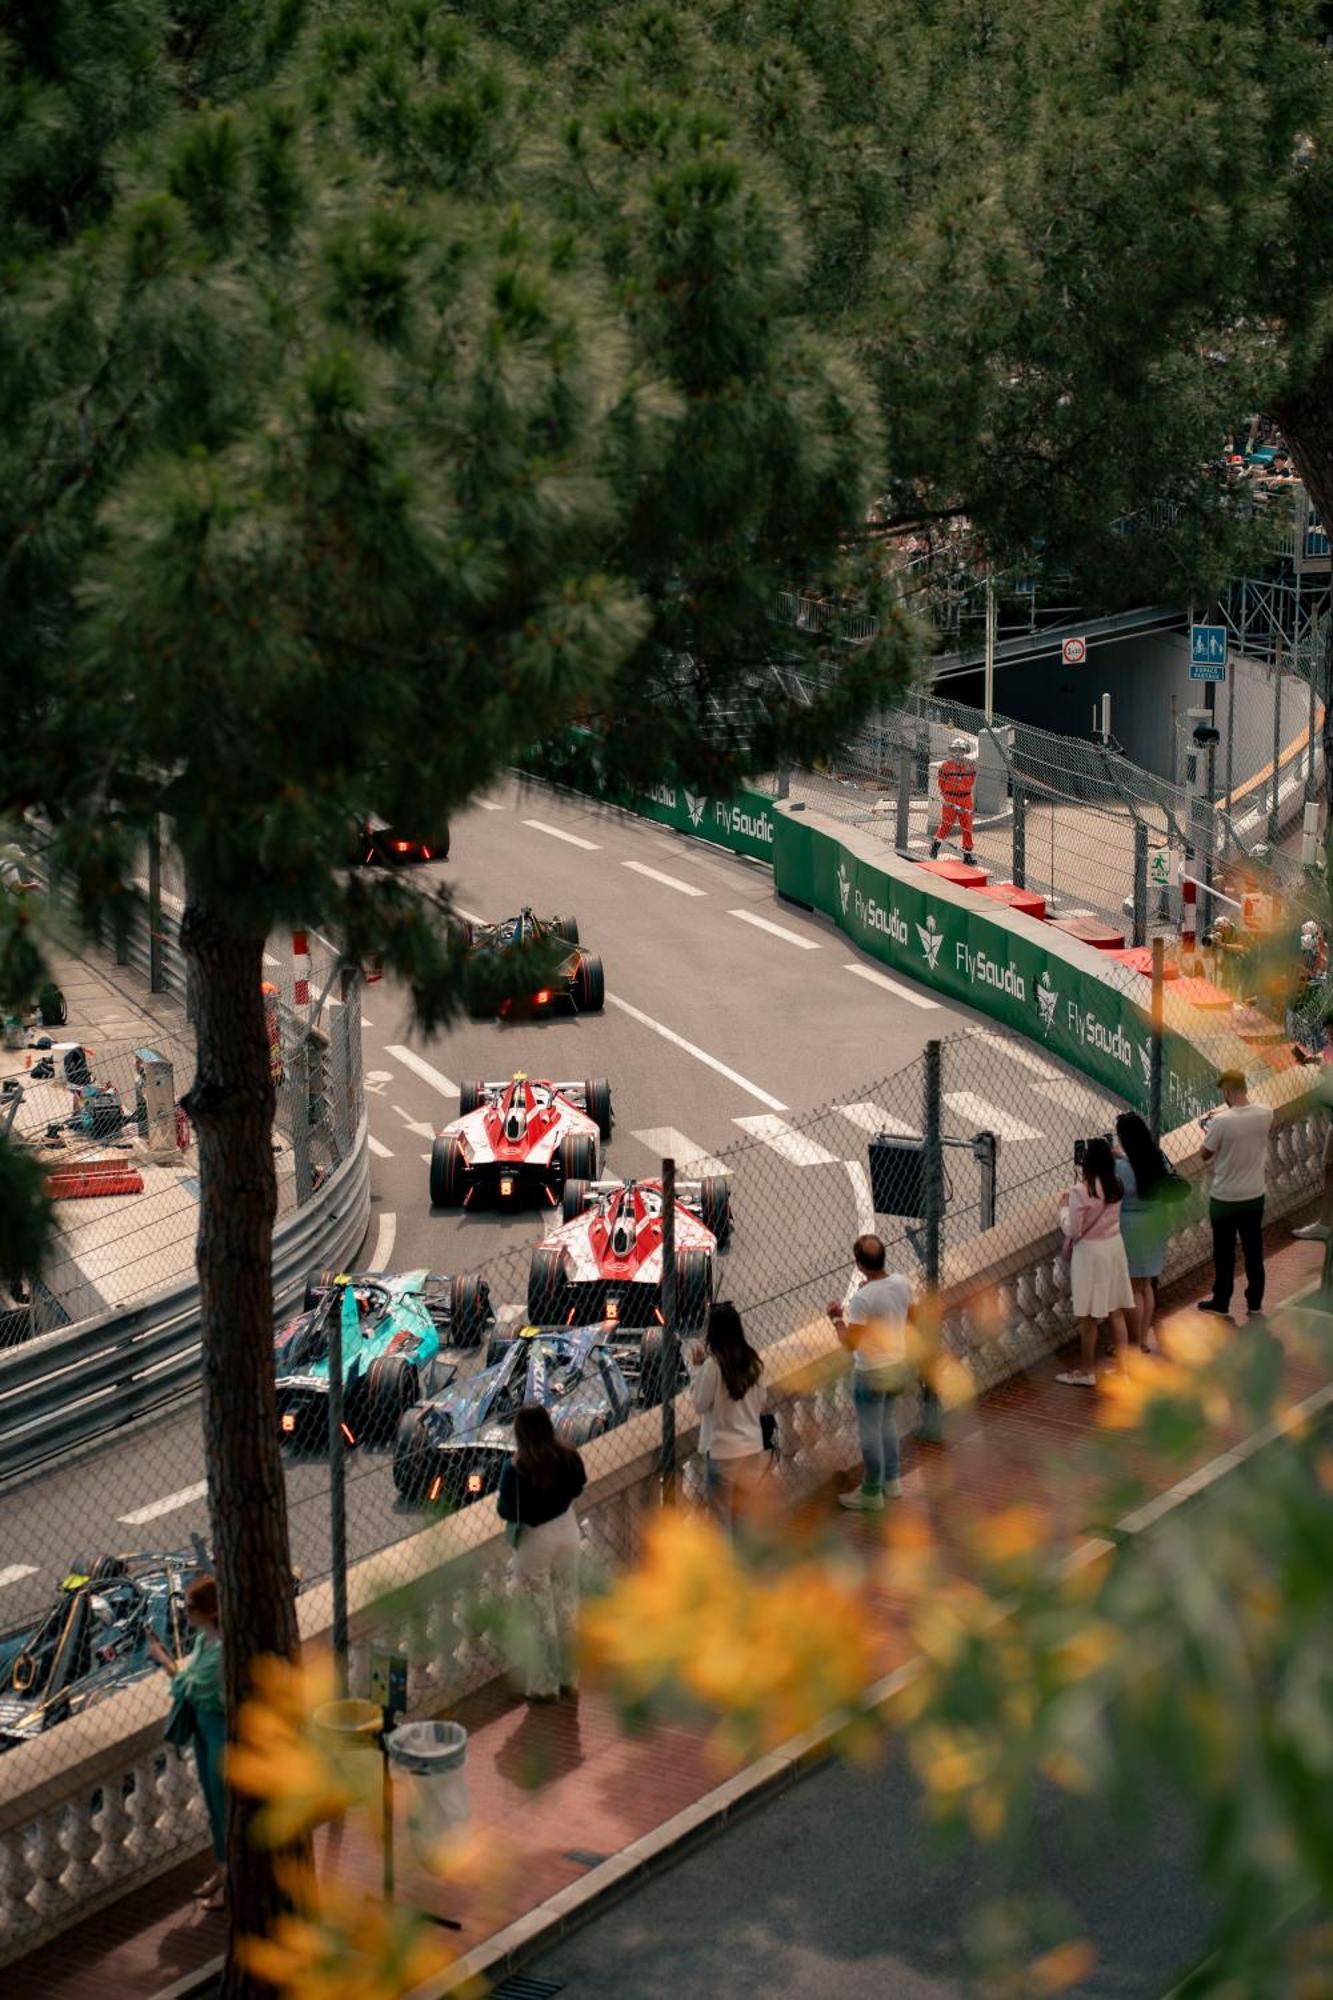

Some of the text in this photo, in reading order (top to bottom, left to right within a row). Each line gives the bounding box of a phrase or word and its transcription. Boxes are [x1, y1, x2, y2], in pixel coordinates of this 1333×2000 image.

[855, 889, 908, 946] FlySaudia
[956, 941, 1026, 1002] FlySaudia
[1068, 1000, 1132, 1068] FlySaudia
